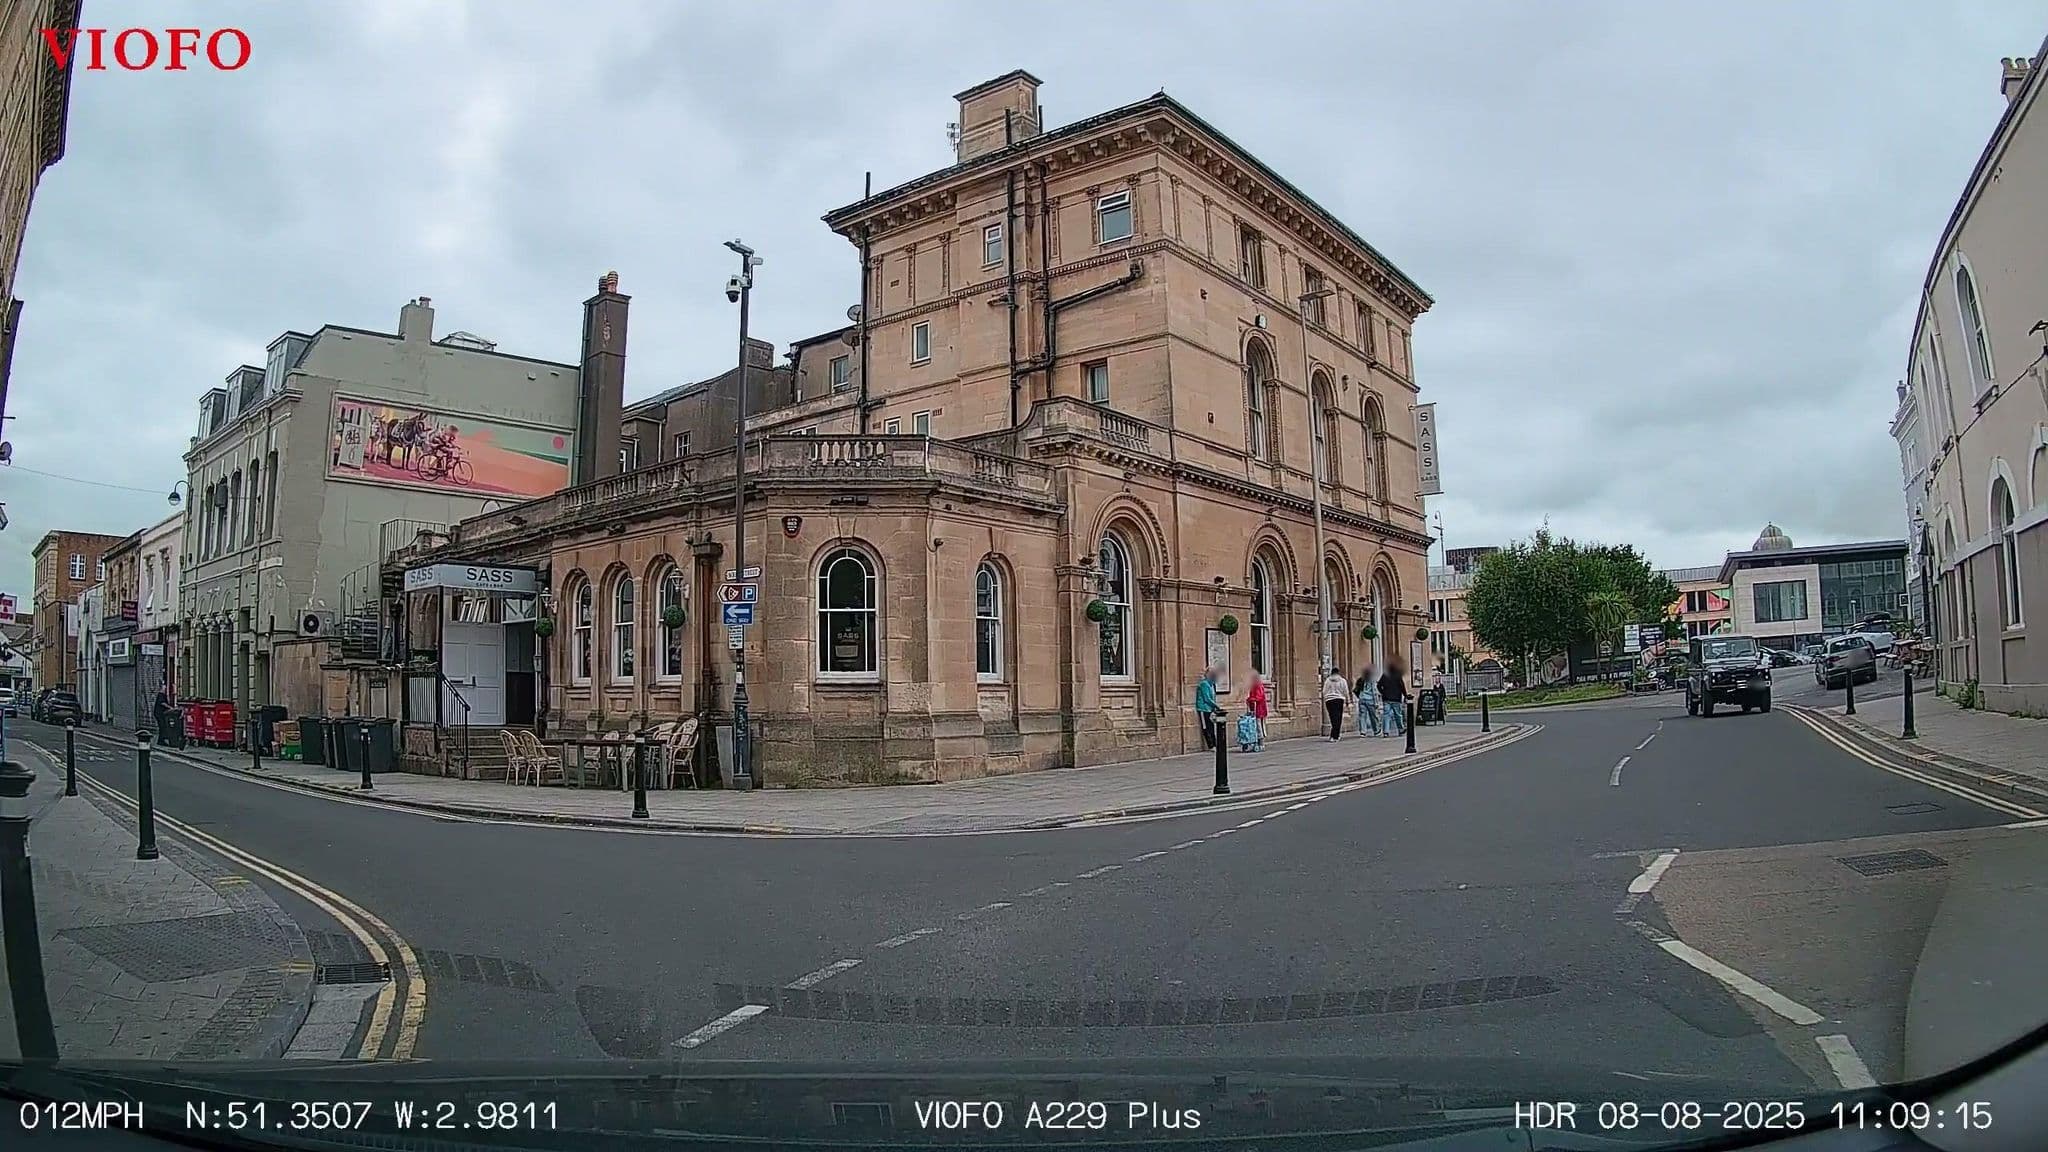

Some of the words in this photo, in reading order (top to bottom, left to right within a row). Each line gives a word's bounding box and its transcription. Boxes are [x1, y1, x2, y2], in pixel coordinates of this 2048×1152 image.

[1420, 412, 1432, 467] SASS
[410, 567, 433, 583] SASS
[466, 567, 513, 583] SASS
[745, 588, 753, 599] P
